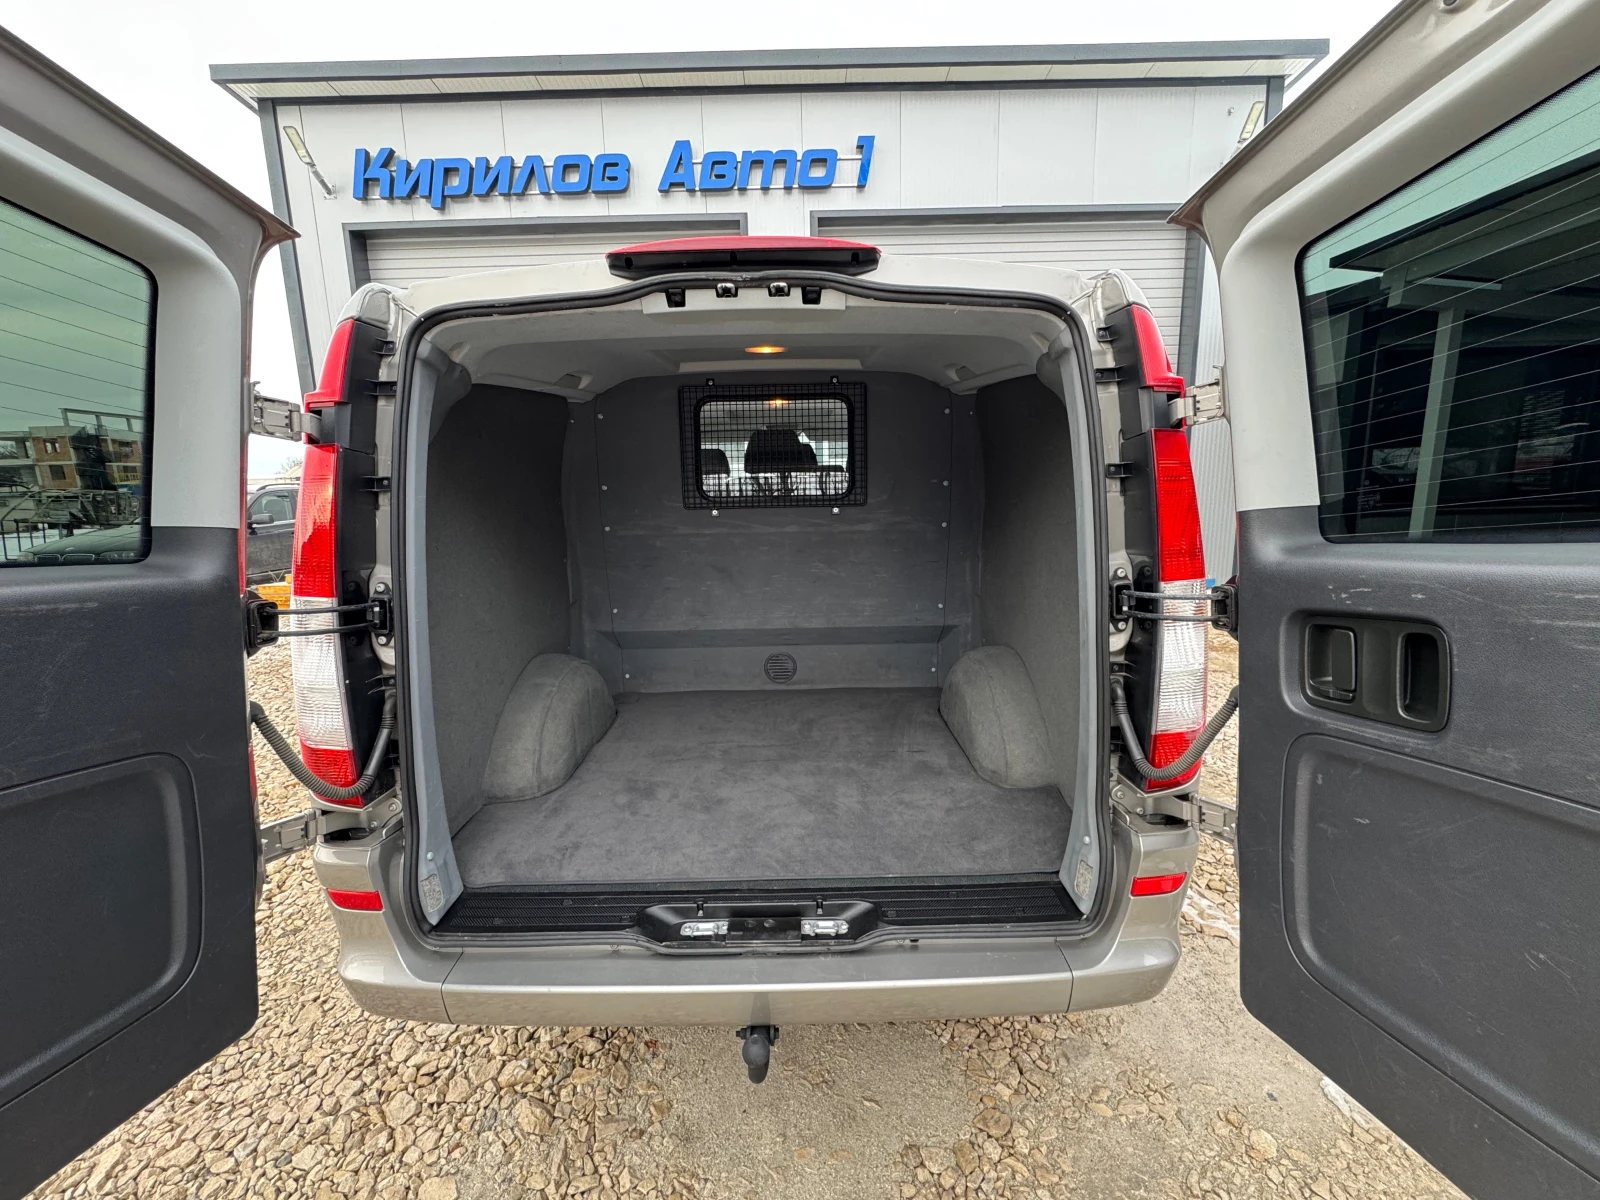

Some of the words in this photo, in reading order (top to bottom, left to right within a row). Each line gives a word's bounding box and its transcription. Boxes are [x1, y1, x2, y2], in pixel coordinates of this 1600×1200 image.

[353, 147, 631, 209] Кирилов
[657, 139, 839, 193] Авто
[856, 135, 876, 188] 1
